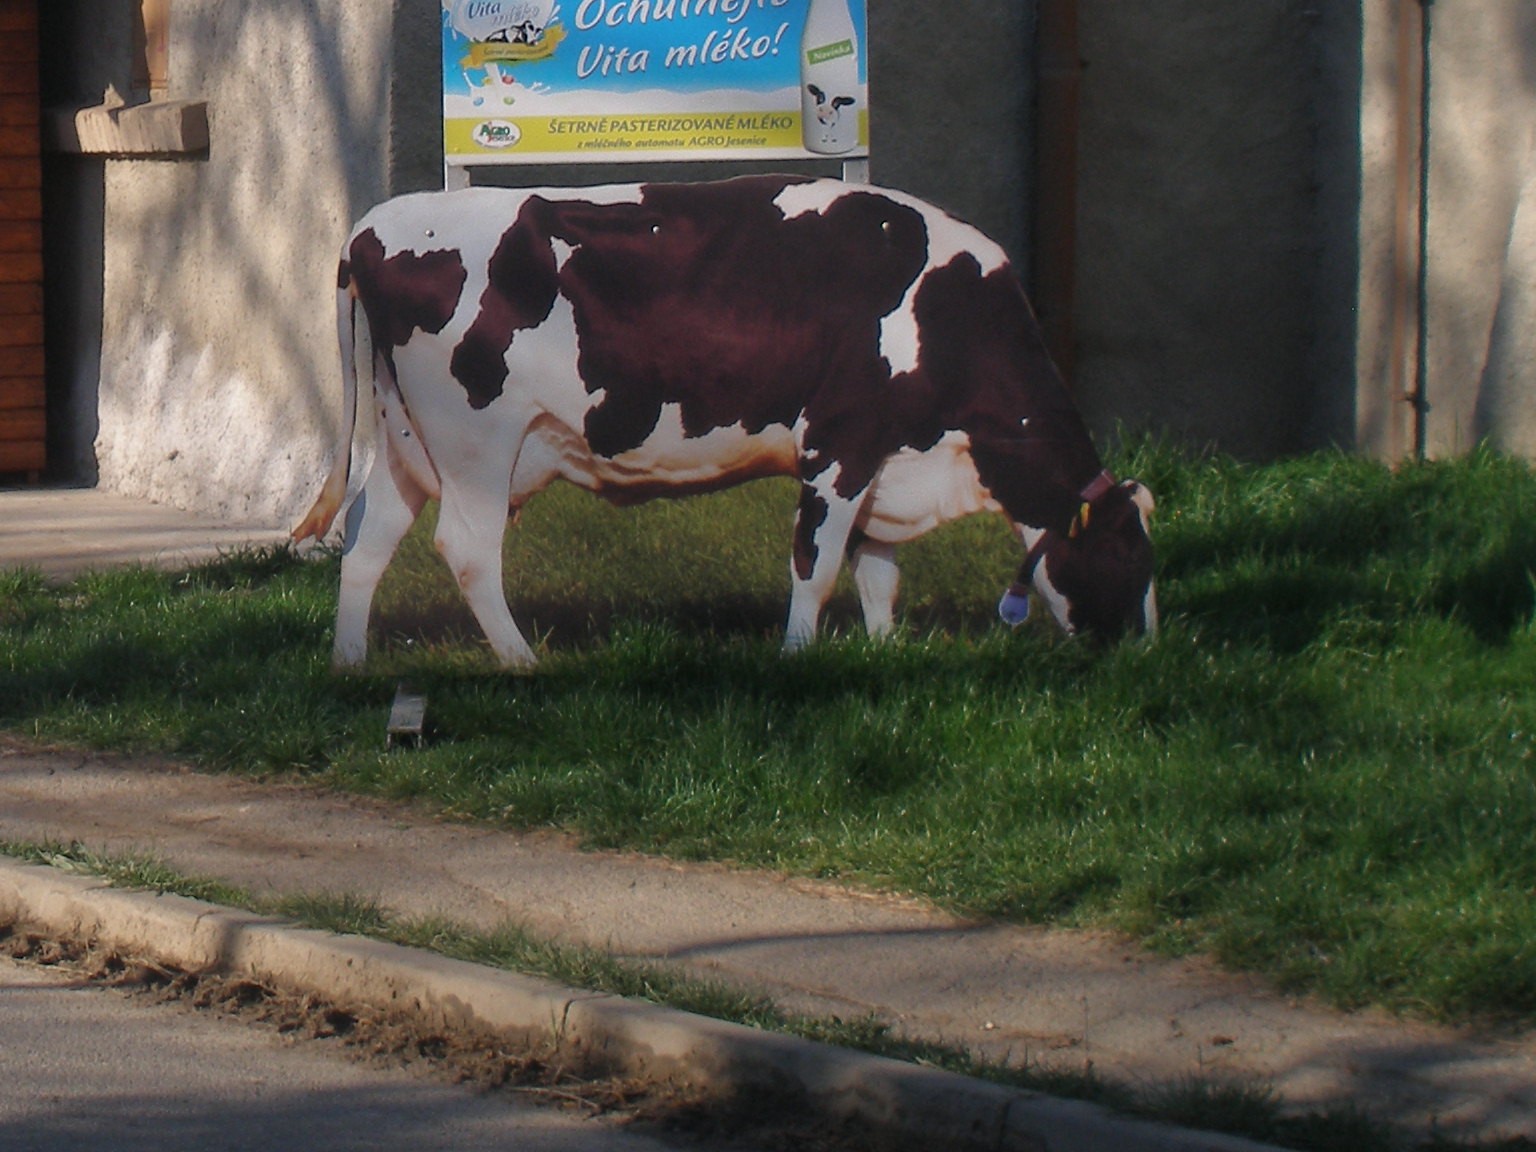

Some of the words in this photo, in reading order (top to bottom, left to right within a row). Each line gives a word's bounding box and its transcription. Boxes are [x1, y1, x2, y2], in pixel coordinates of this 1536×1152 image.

[468, 0, 502, 19] Vita
[576, 46, 647, 80] Vita
[663, 22, 790, 69] mléko!
[609, 115, 735, 132] PASTERIZOVANÉ
[735, 113, 794, 131] MLÉKO
[583, 137, 633, 149] mléčného
[635, 137, 685, 148] automatu
[688, 135, 725, 147] AGRO
[724, 135, 768, 148] Jesenice
